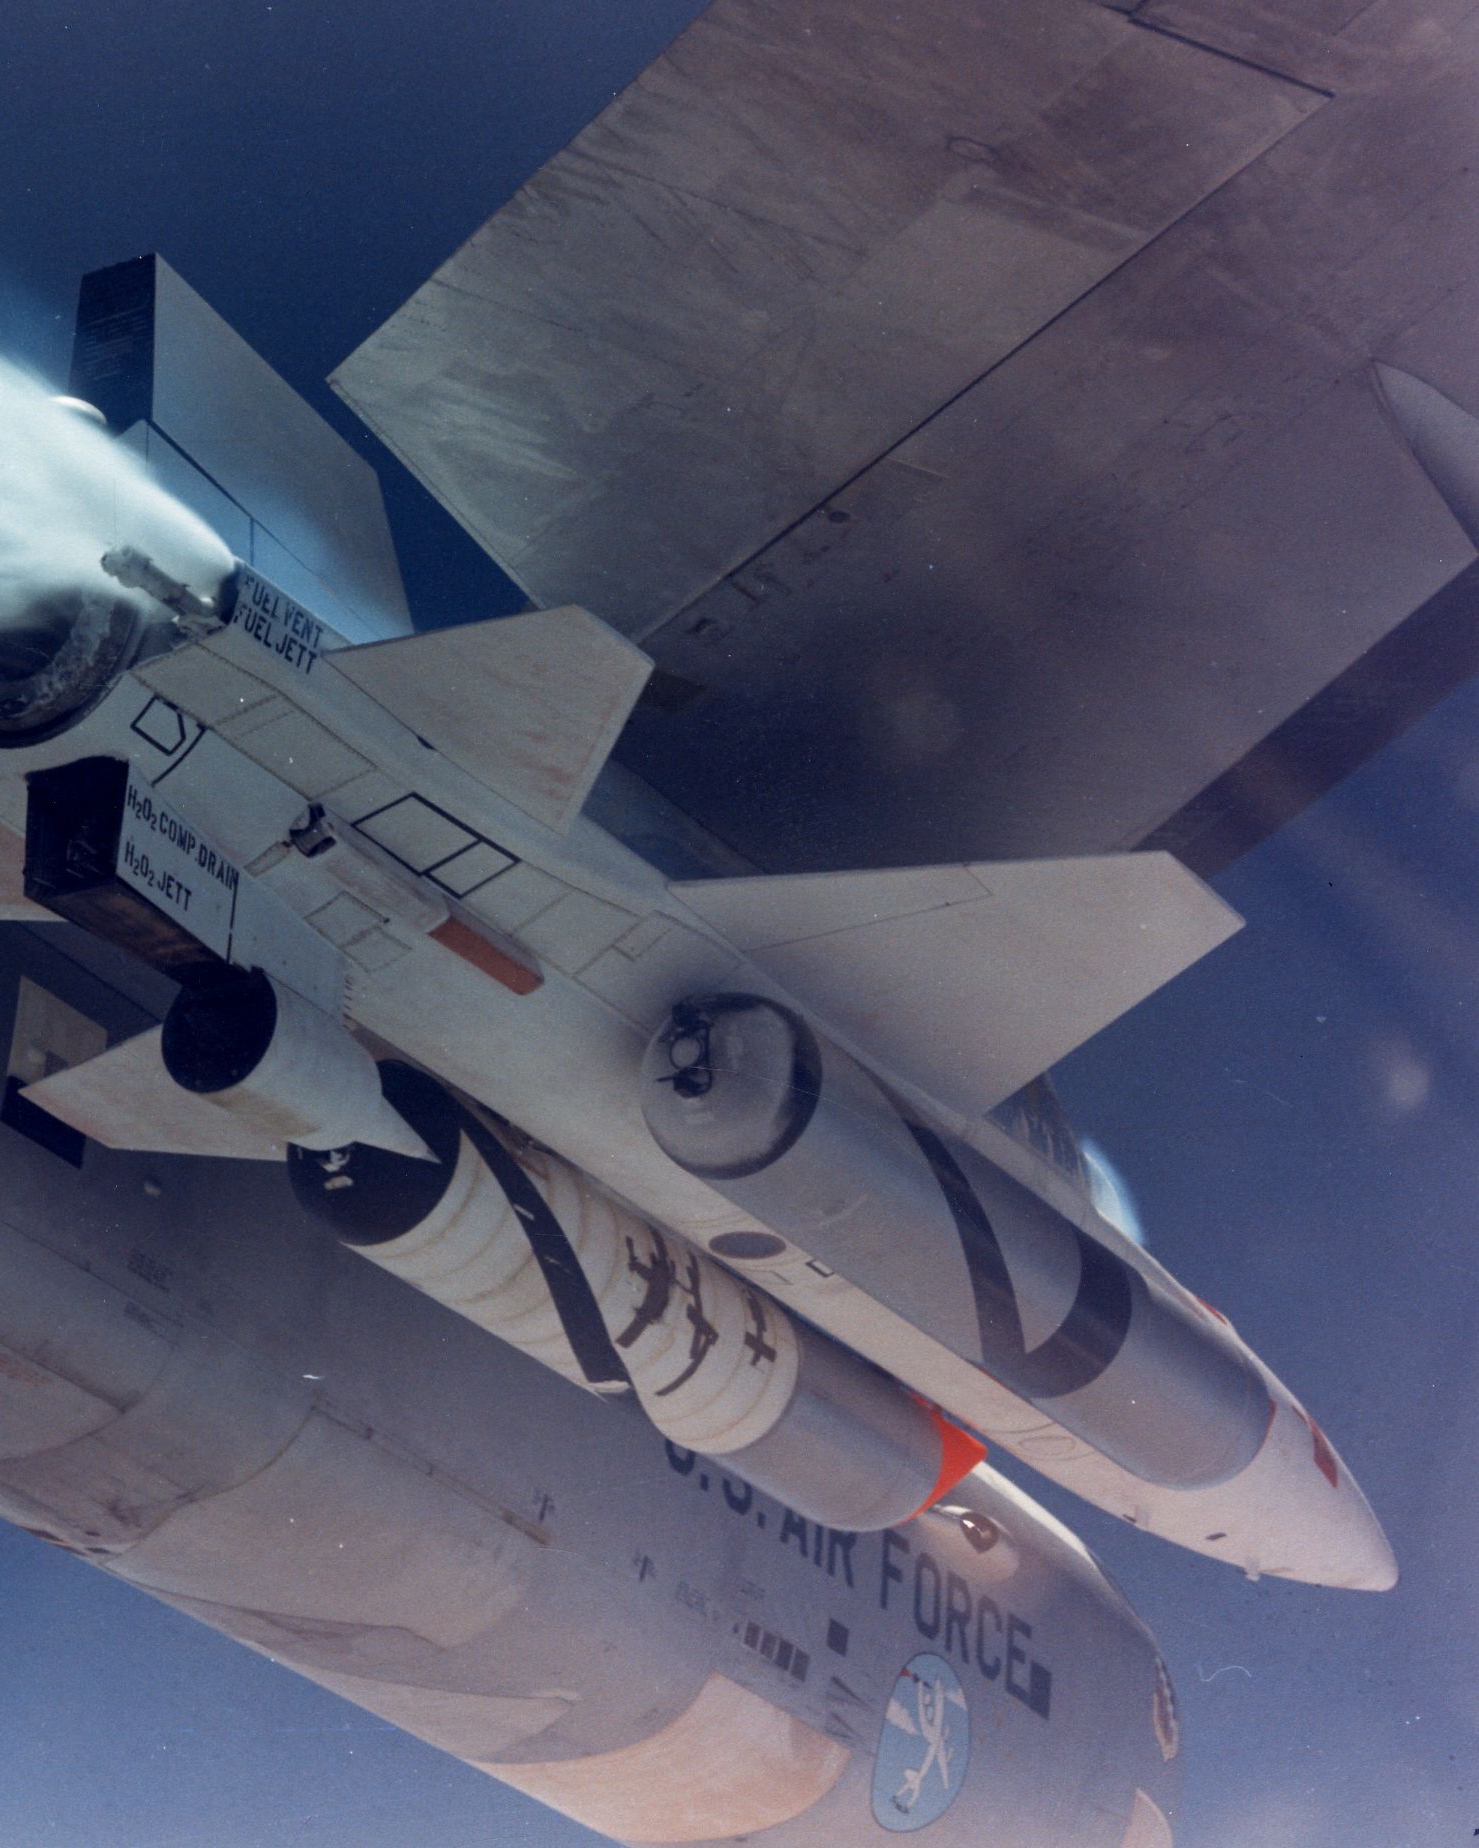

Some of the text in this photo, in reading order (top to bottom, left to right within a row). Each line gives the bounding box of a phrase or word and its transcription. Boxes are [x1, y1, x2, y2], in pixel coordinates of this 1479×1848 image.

[232, 603, 318, 675] FUEL JETT
[244, 573, 324, 649] FUEL VENT
[157, 871, 193, 912] JETT
[198, 843, 240, 891] DRAIN
[879, 1527, 1034, 1706] FORCE
